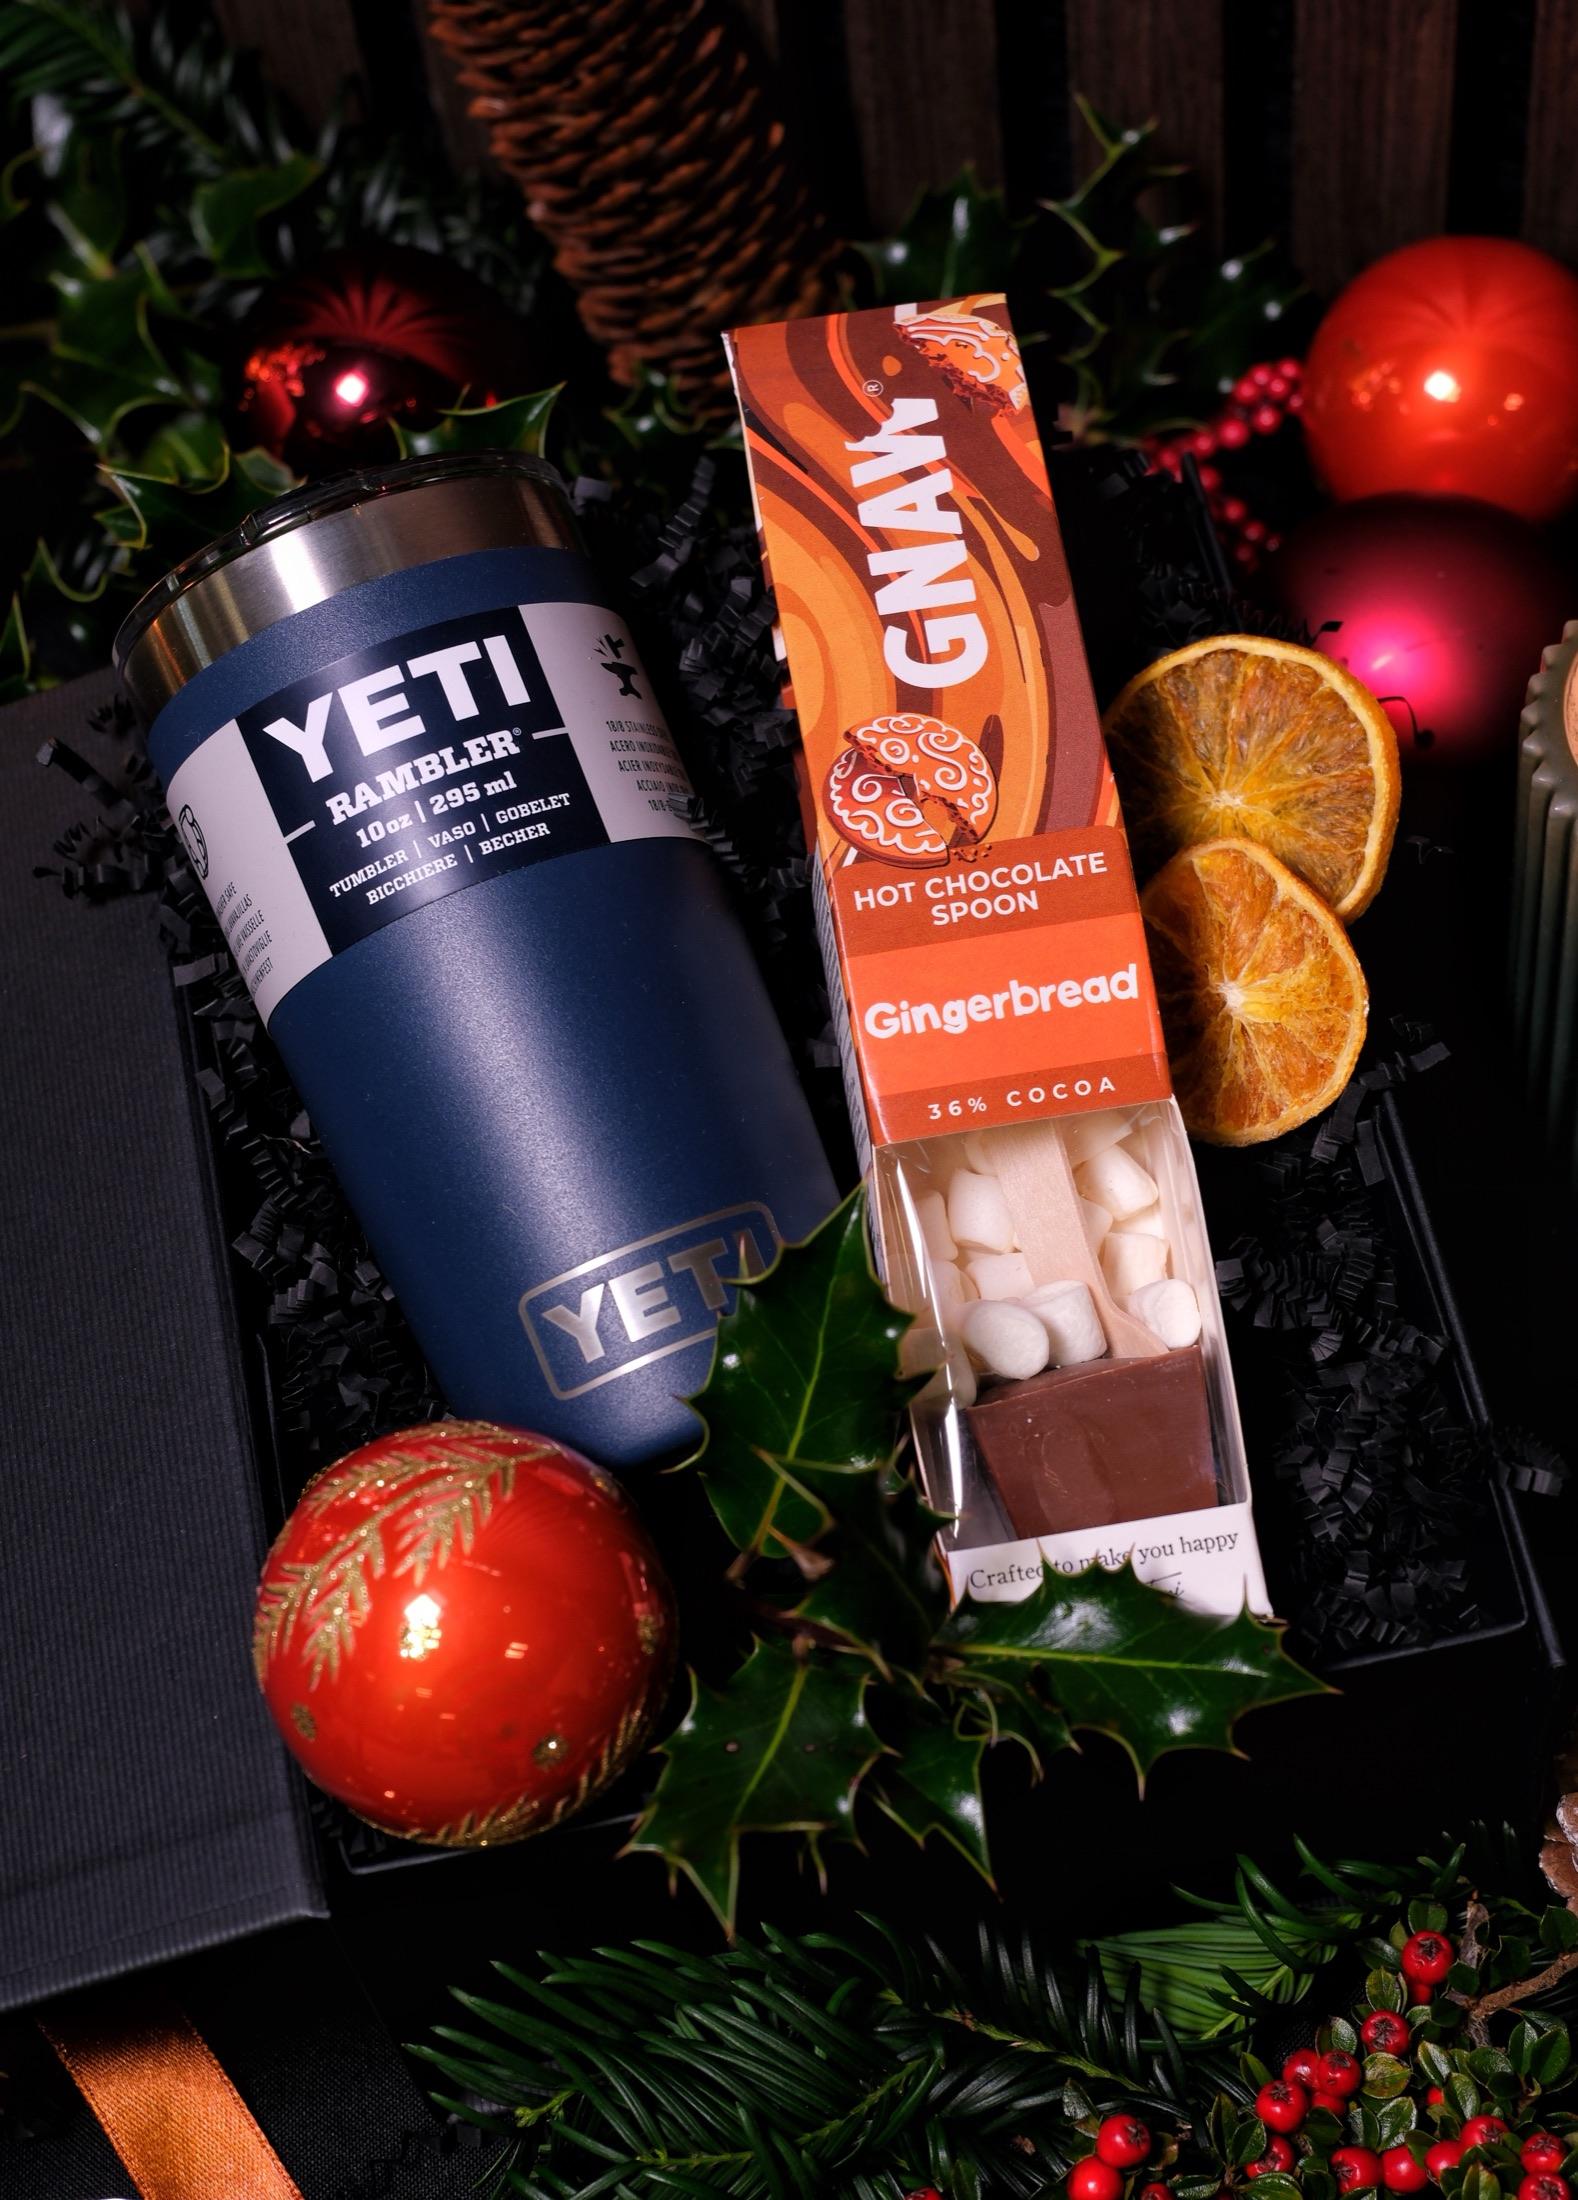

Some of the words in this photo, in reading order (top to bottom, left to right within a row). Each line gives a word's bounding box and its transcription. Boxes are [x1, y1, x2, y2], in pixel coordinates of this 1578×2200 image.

[263, 635, 531, 783] YETI
[609, 740, 636, 752] ACERO
[618, 759, 642, 772] ACIER
[356, 814, 413, 848] 10oz
[429, 782, 481, 815] 295
[484, 771, 518, 796] ml
[329, 850, 409, 899] TUMBLER
[428, 821, 477, 849] VASO
[496, 793, 570, 825] GOBELET
[366, 854, 458, 905] BICCHIERE
[479, 823, 551, 856] BECHER
[853, 881, 916, 911] HOT
[925, 852, 1108, 899] CHOCOLATE
[932, 890, 1039, 926] SPOON
[864, 963, 1139, 1040] Gingerbread
[927, 1096, 988, 1120] 36%
[1006, 1077, 1116, 1107] COCOA
[1054, 1557, 1075, 1574] to
[1138, 1544, 1174, 1565] you
[1180, 1532, 1239, 1556] happy
